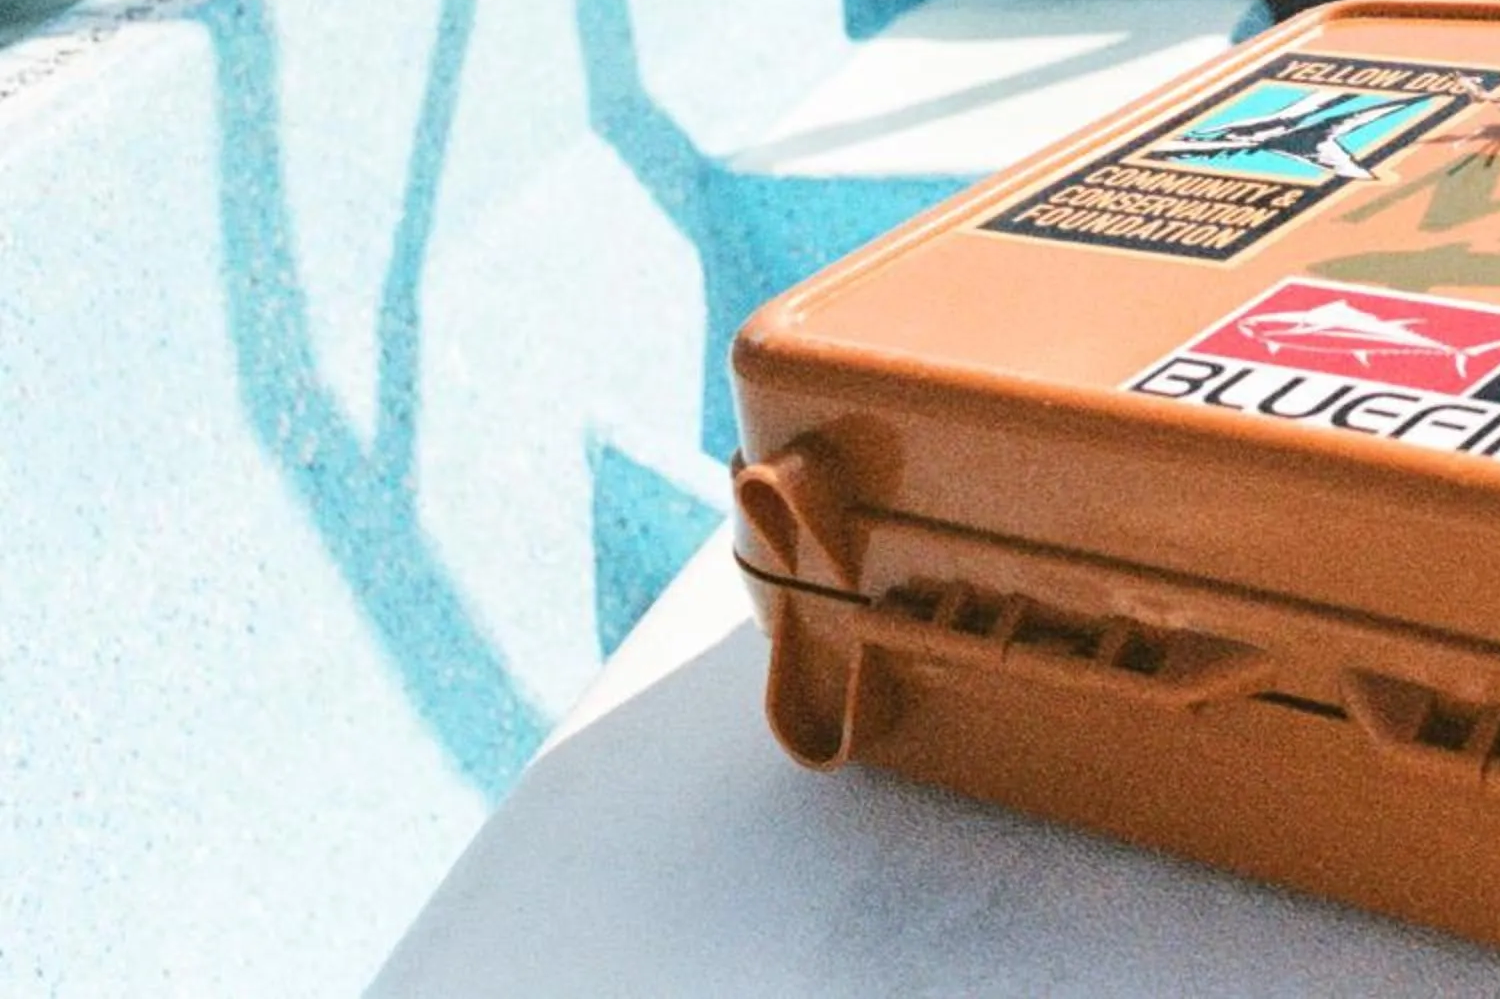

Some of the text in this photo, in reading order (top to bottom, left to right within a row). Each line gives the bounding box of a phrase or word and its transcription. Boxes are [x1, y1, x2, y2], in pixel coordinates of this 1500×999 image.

[1277, 60, 1413, 88] YELLOW
[1049, 185, 1279, 229] CONSERVATION
[1084, 165, 1304, 208] COMMUNITY &
[1012, 203, 1248, 249] FOUNDATION
